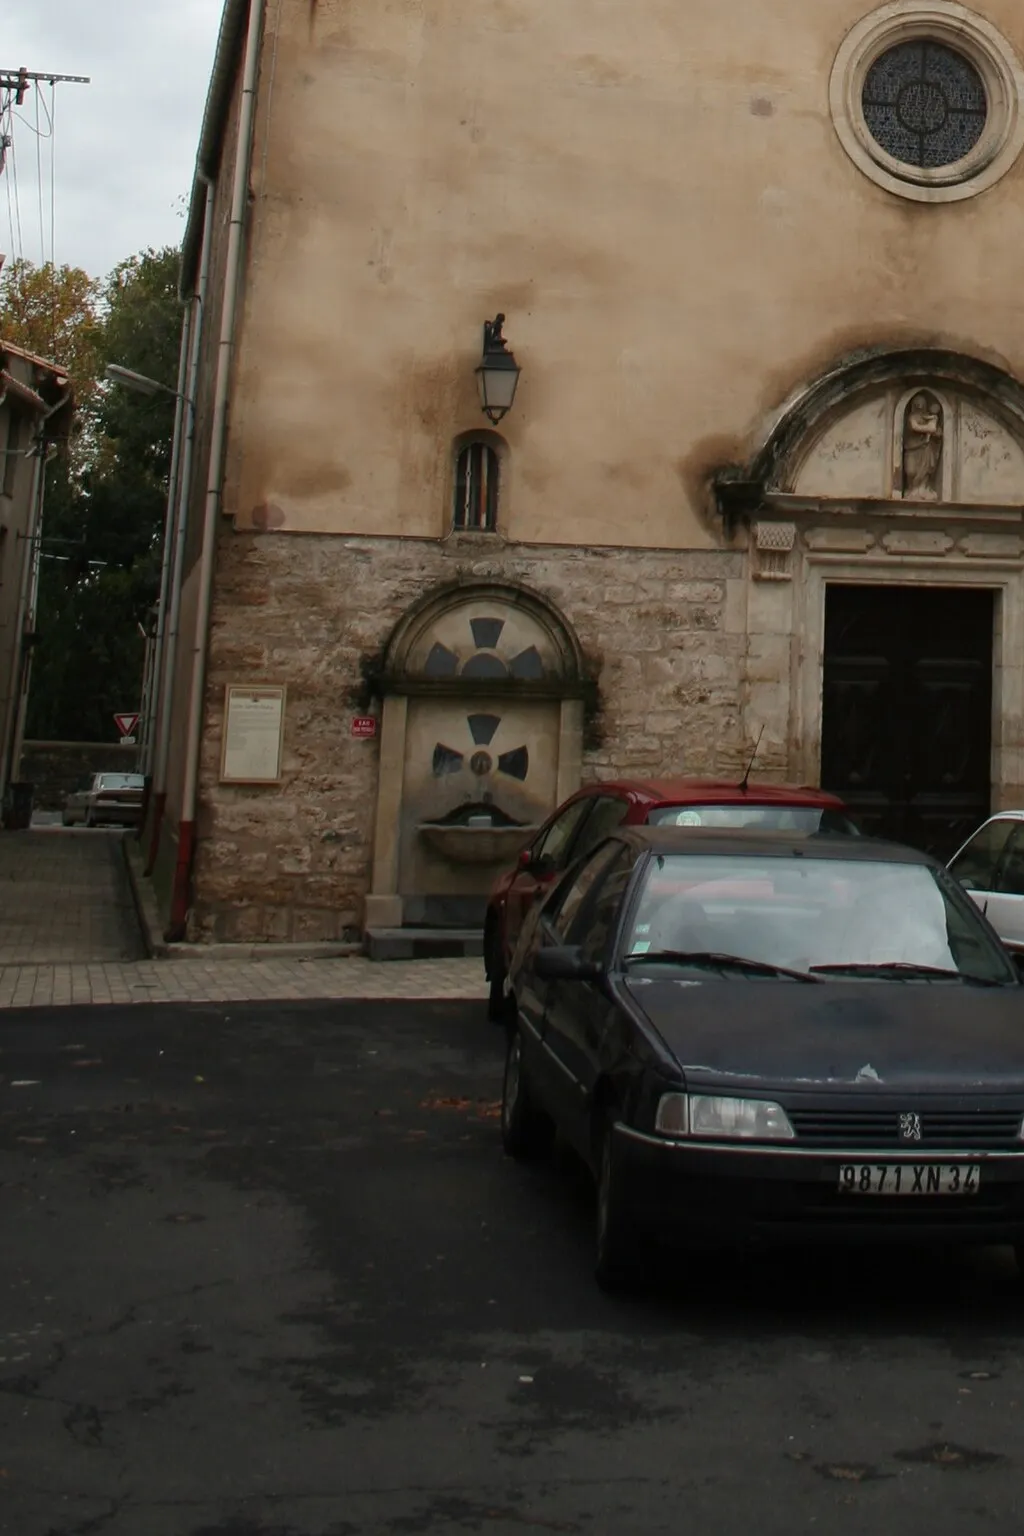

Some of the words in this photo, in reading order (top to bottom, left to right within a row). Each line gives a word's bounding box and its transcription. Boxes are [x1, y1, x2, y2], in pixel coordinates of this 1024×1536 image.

[843, 1166, 902, 1192] 9871
[911, 1166, 941, 1192] XN
[948, 1166, 976, 1192] 34
